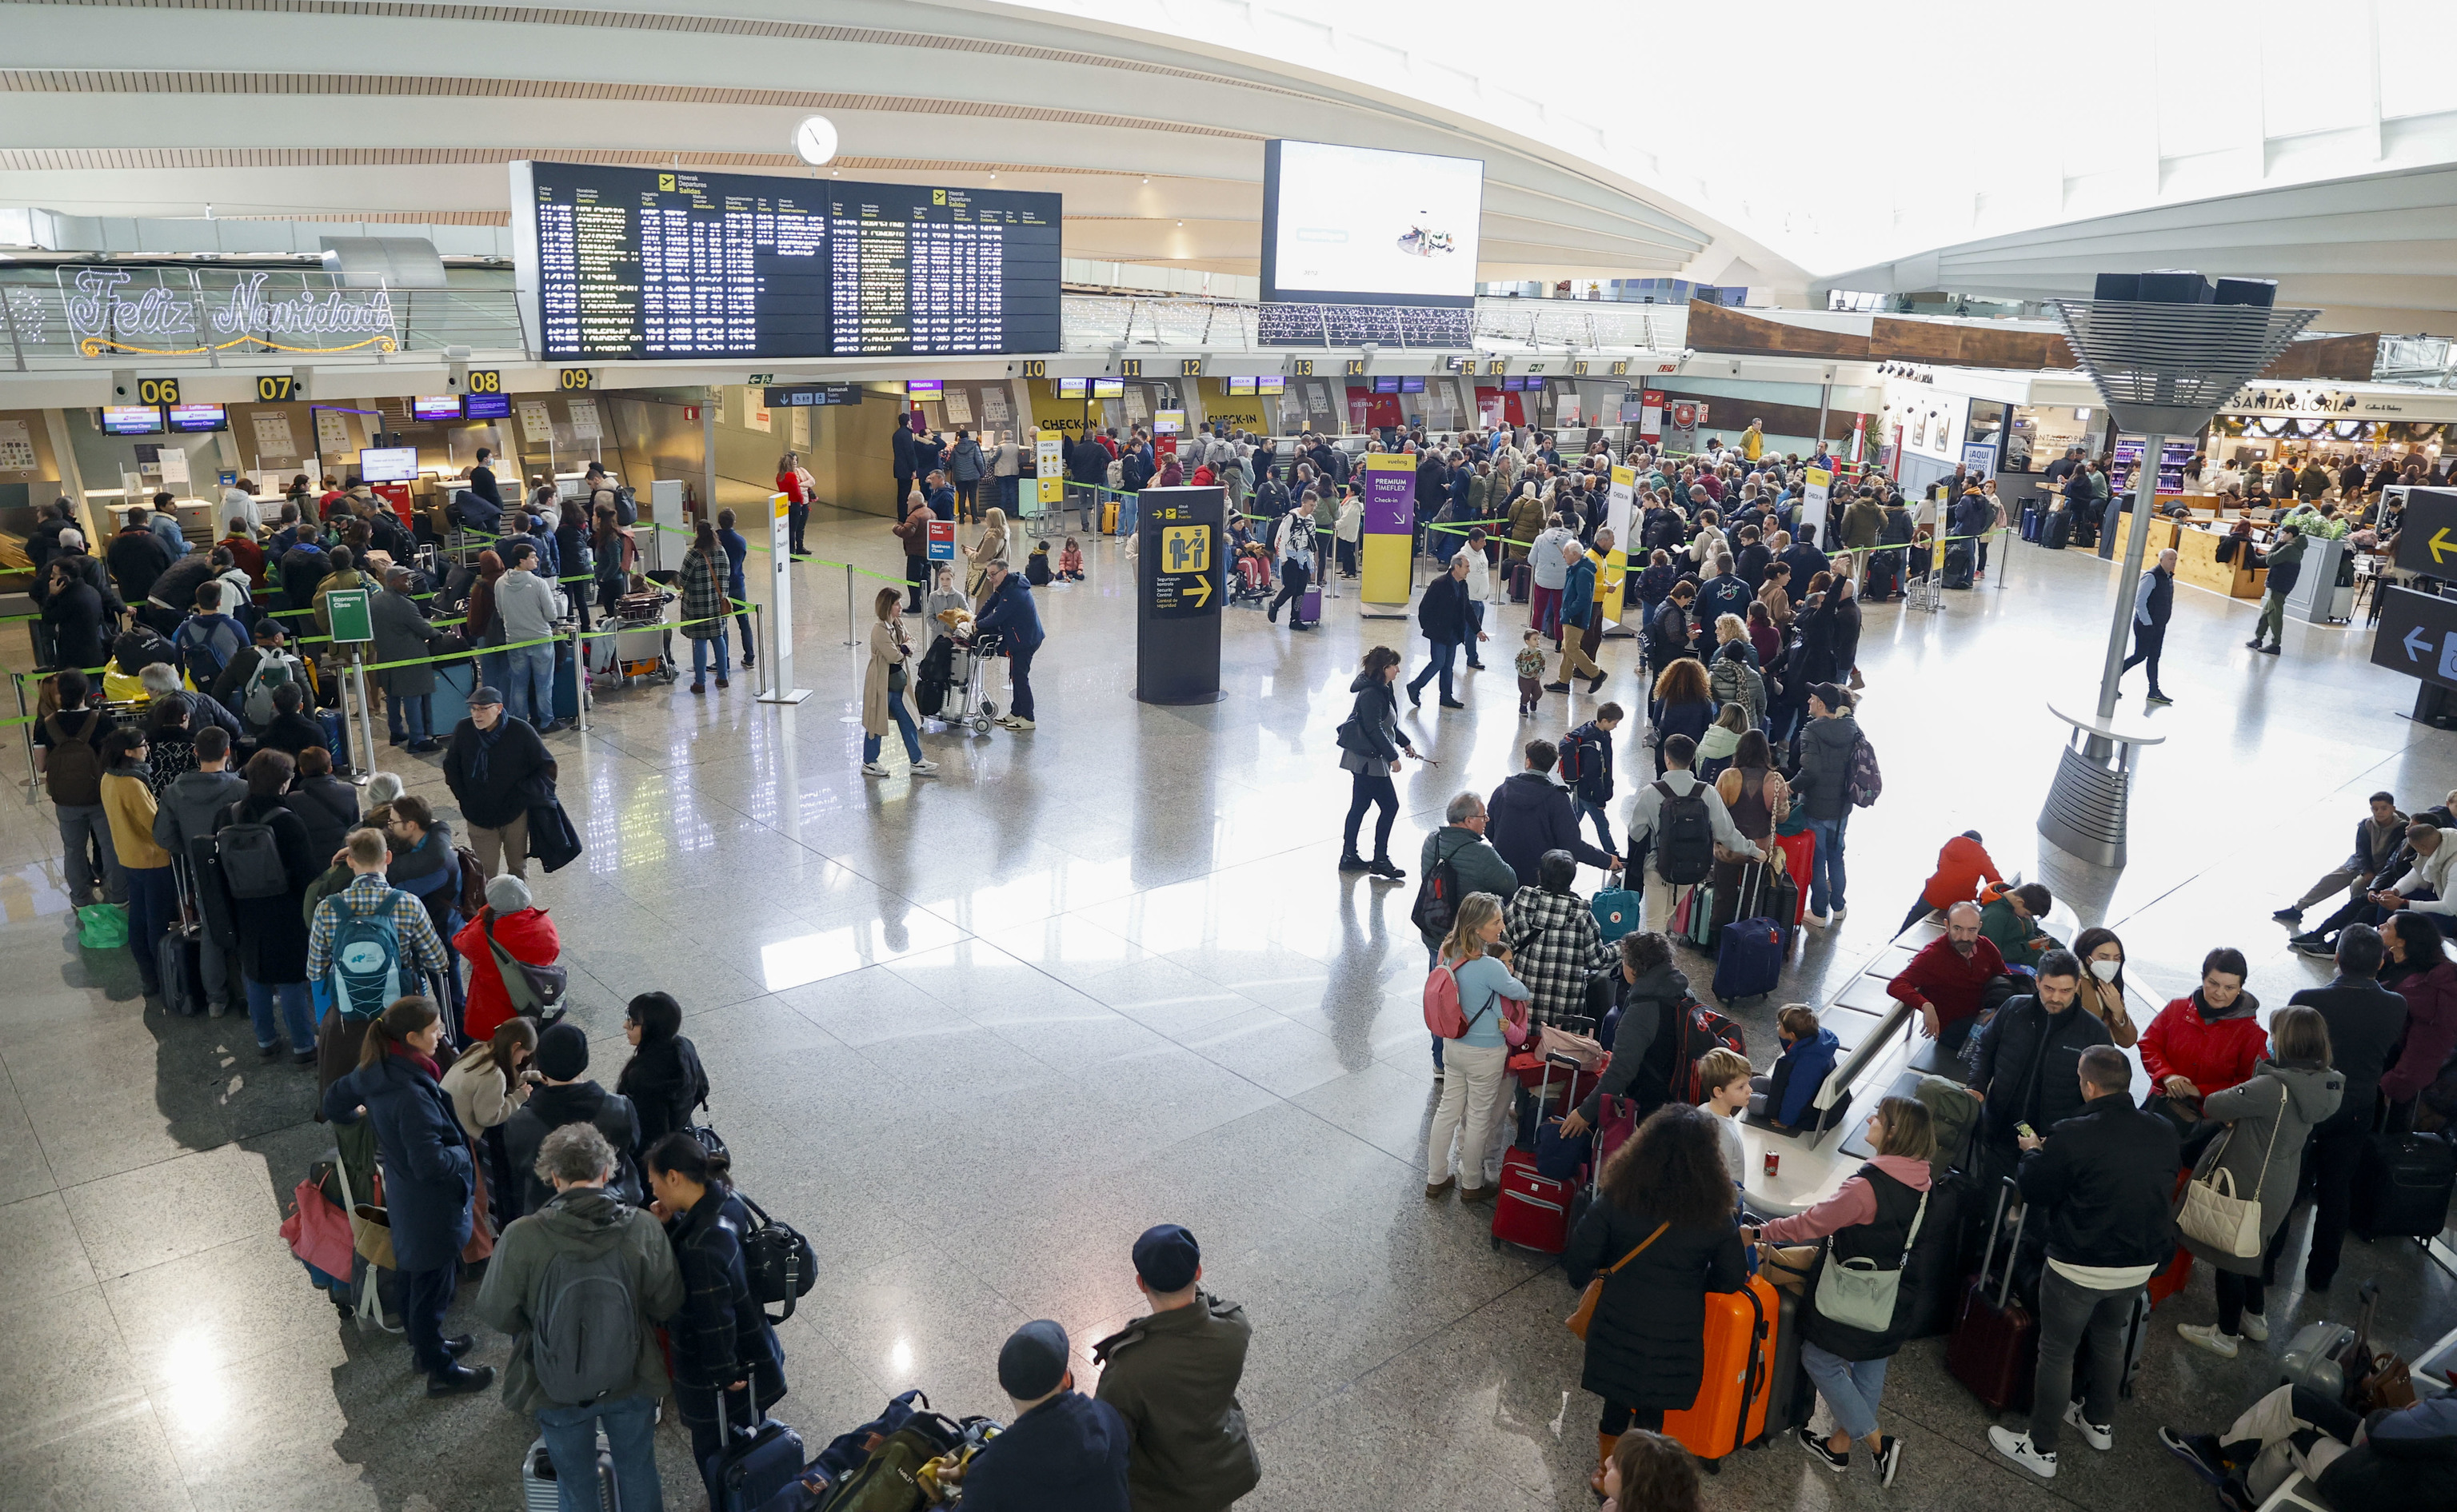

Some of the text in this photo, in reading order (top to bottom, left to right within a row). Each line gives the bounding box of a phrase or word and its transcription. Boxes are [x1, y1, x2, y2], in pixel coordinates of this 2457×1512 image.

[70, 270, 389, 336] Feliz Navidad
[1025, 361, 1044, 377] 10
[1123, 361, 1139, 376] 11
[1184, 361, 1201, 376] 12
[1296, 361, 1312, 376] 13
[1348, 361, 1363, 375] 14
[1461, 361, 1475, 375] 15
[1490, 361, 1504, 375] 16
[1575, 362, 1588, 375] 17
[1614, 362, 1625, 375] 18
[470, 372, 499, 393] 08
[562, 369, 588, 389] 09
[141, 380, 178, 403] 06
[259, 377, 291, 399] 07
[1042, 419, 1098, 429] CHECK-IN
[1969, 450, 1990, 459] ¡AQUÍ
